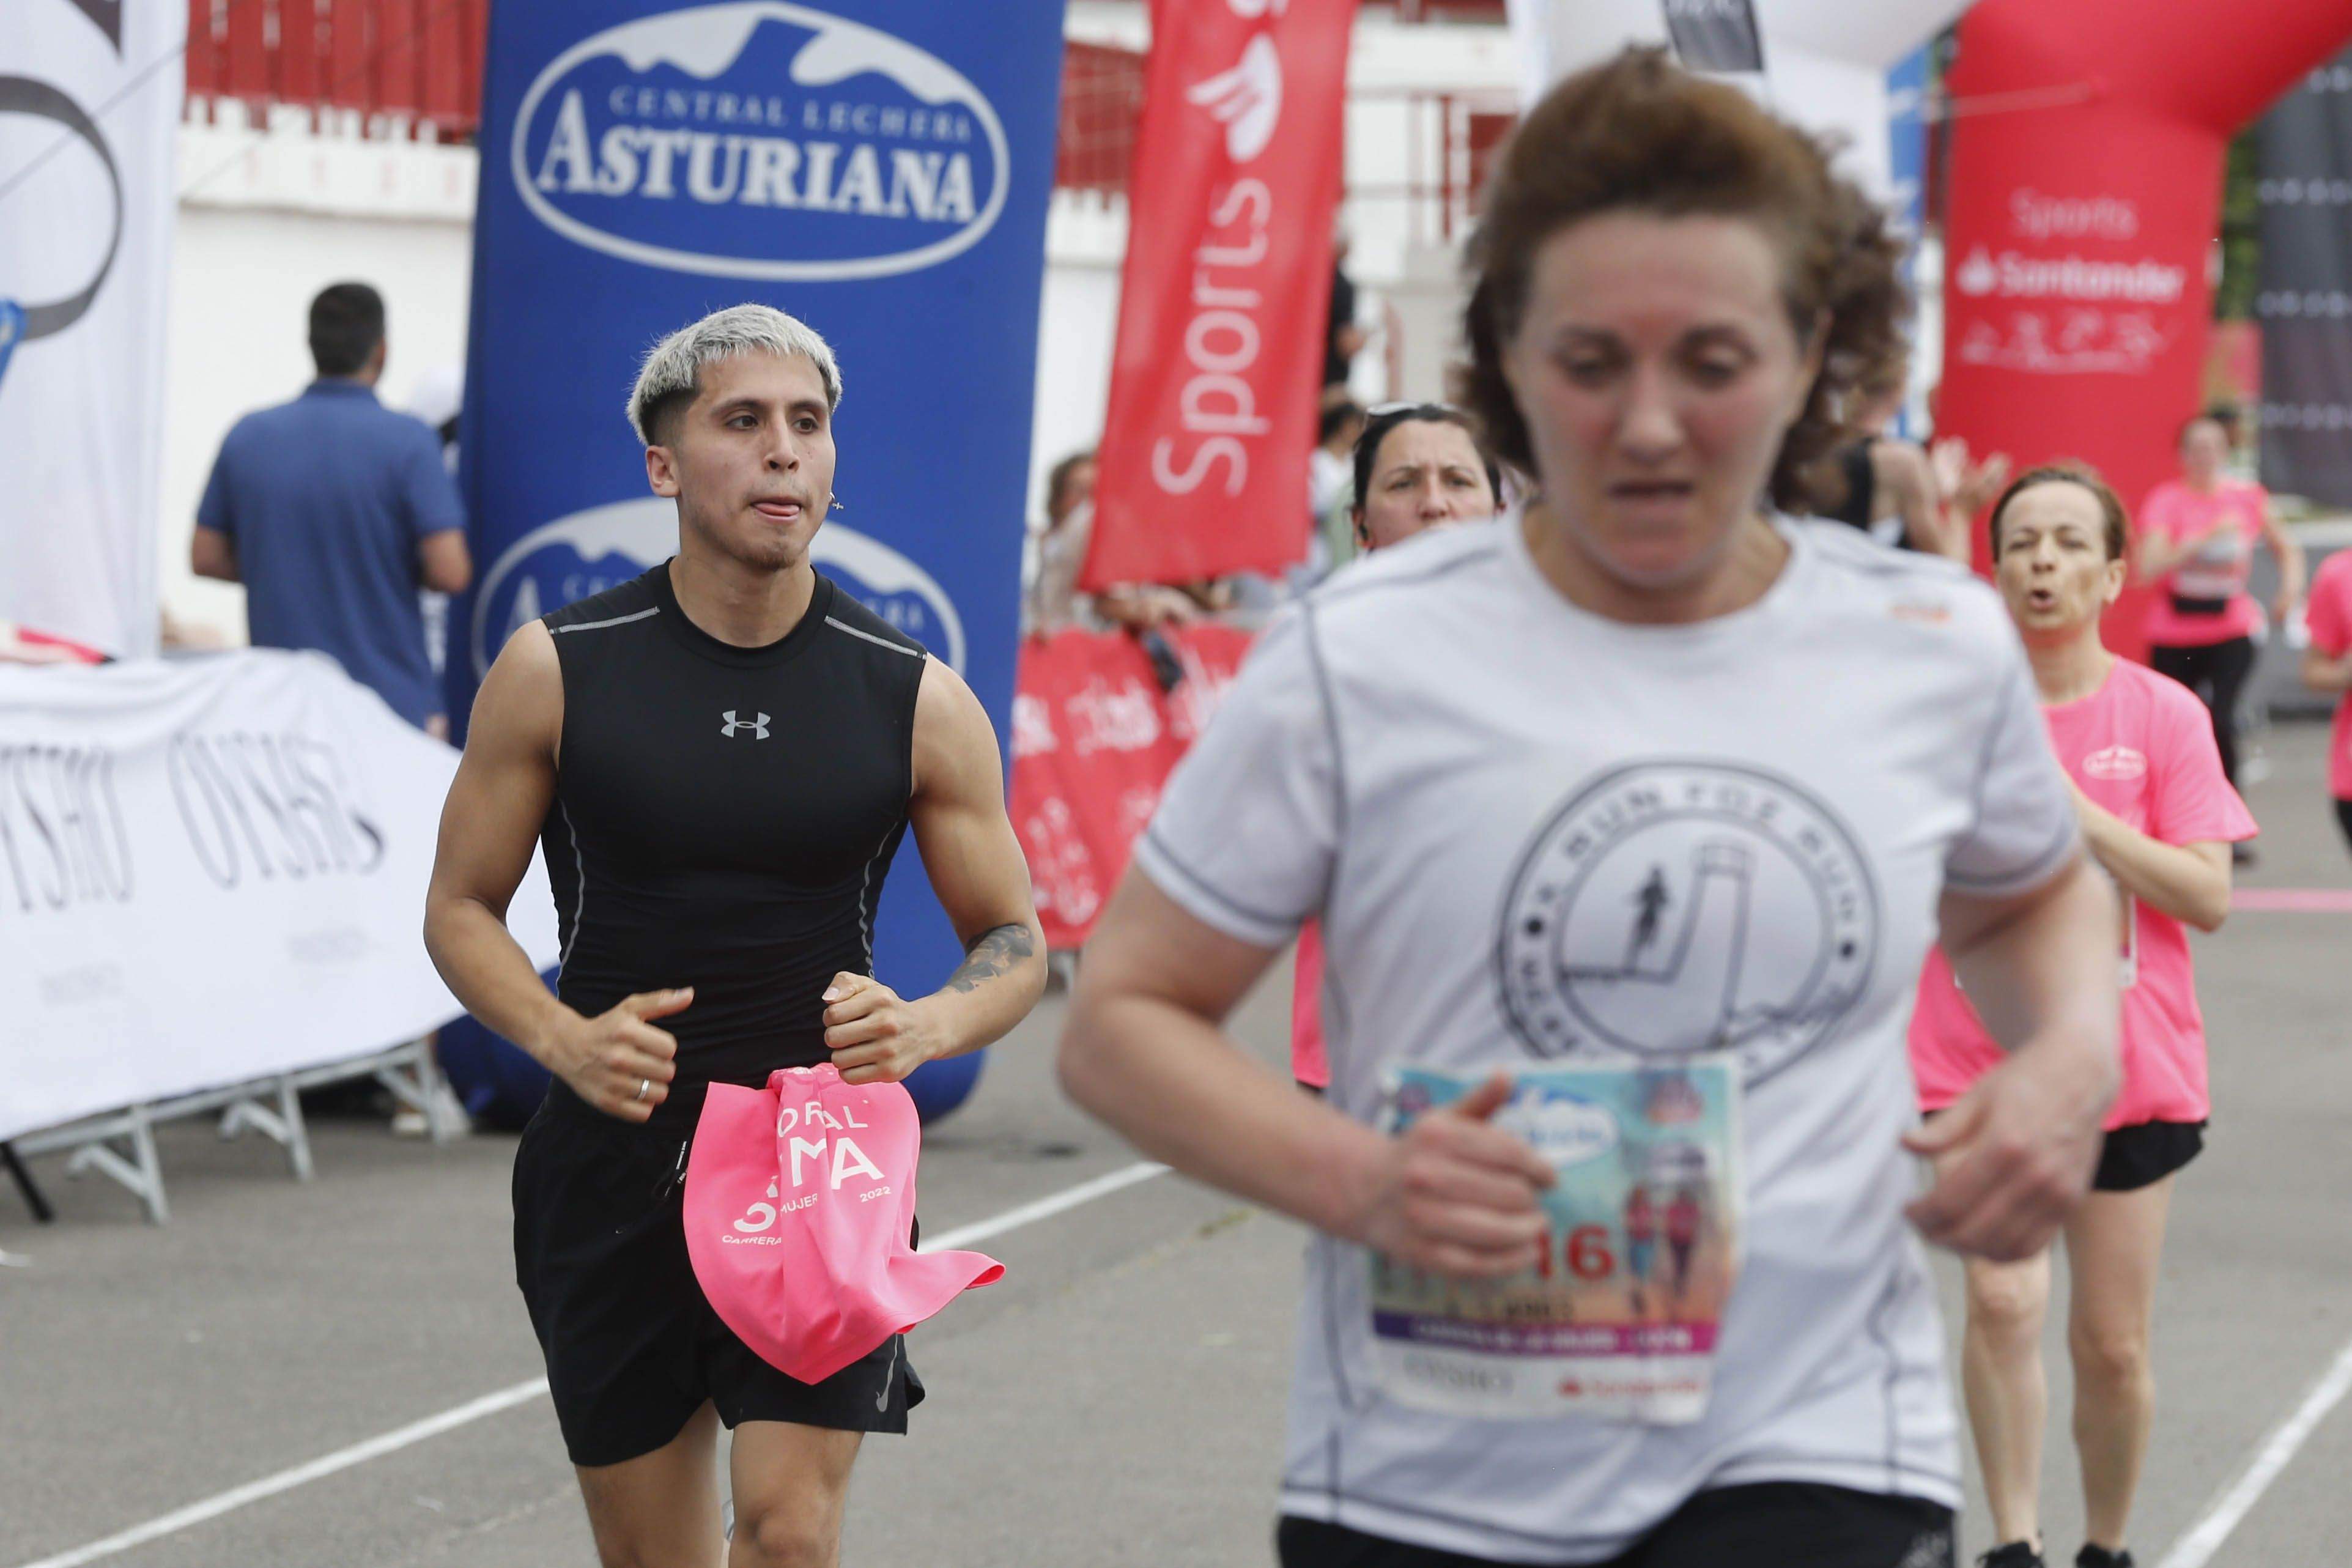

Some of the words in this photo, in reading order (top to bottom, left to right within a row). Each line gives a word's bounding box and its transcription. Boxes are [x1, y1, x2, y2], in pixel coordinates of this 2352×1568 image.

[536, 88, 977, 222] ASTURIANA
[610, 86, 789, 126] CENTRAL
[802, 99, 972, 143] LECHERA
[1152, 177, 1274, 497] Sports
[722, 1234, 782, 1246] CARRERA
[780, 1193, 818, 1214] MUJER
[859, 1186, 892, 1203] 2022
